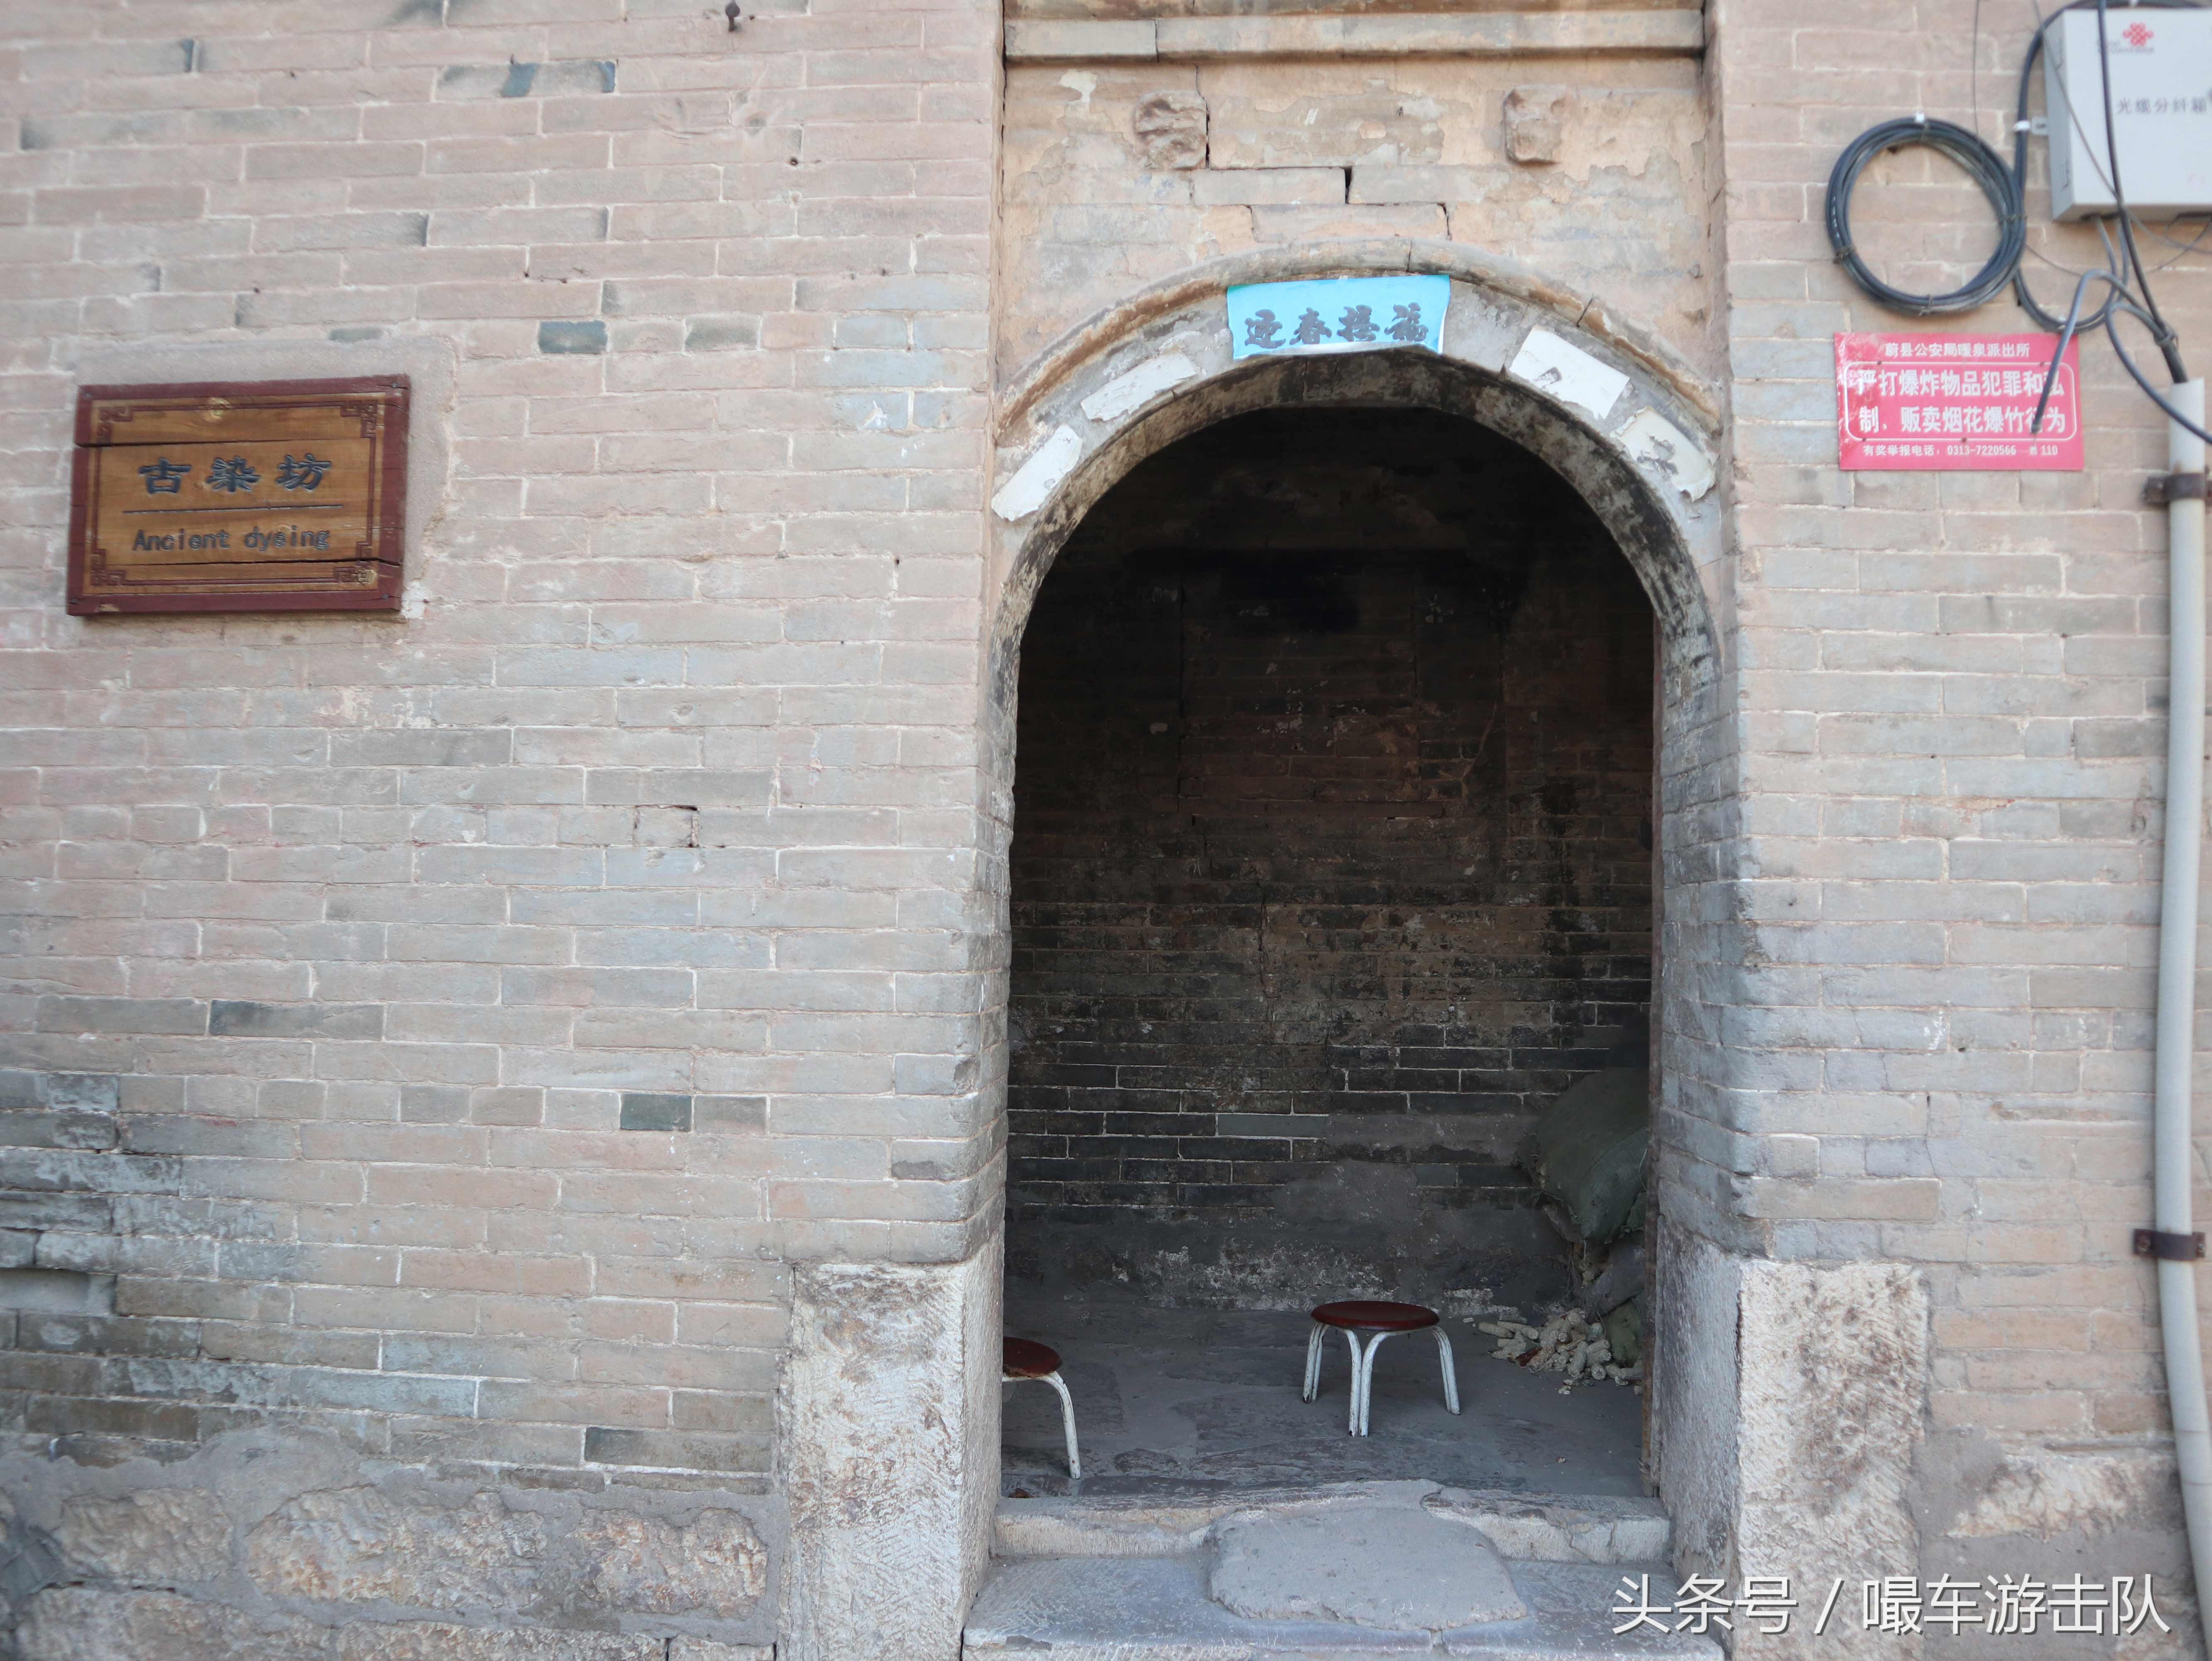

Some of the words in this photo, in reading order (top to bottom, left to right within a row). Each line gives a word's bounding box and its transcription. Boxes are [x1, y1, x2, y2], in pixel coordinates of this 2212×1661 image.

[1885, 343, 2030, 358] 蔚县公安局暖泉派出所
[137, 452, 332, 495] 古染坊
[132, 529, 230, 551] Ancient
[244, 524, 330, 551] dyeing
